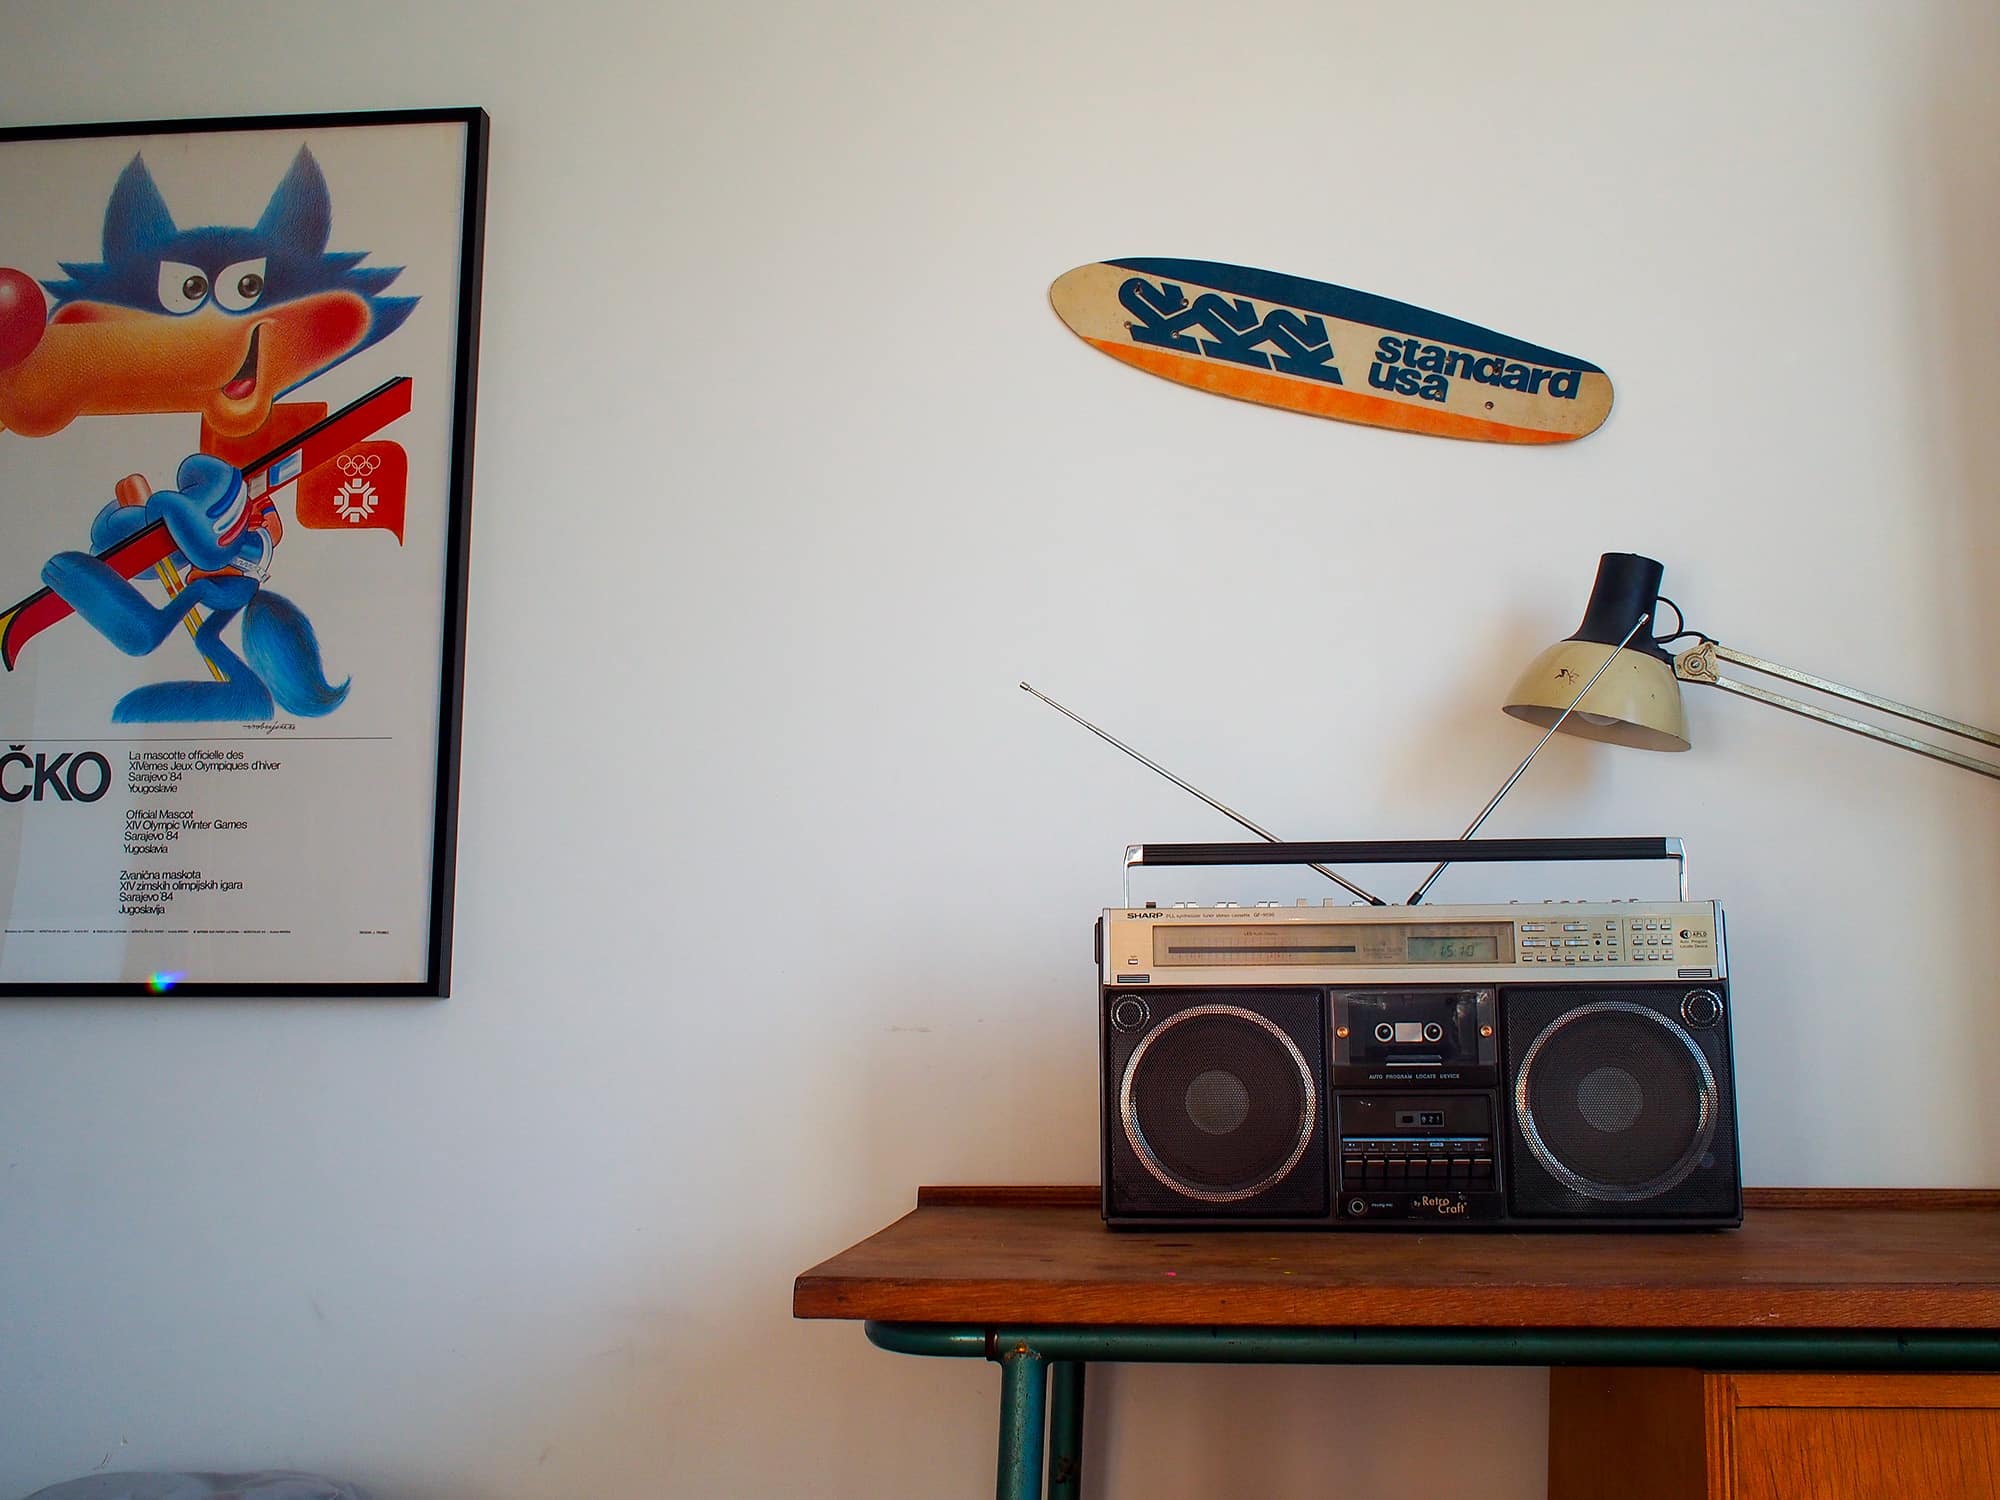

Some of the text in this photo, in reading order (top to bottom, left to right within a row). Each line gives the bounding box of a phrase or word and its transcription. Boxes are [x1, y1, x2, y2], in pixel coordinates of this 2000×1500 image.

[1375, 335, 1582, 400] standard
[1368, 362, 1448, 402] usa
[129, 750, 244, 760] La mascotte officielle des
[170, 761, 193, 771] Jeux
[195, 760, 249, 773] Olympiques
[251, 760, 281, 770] d'hiver
[0, 745, 112, 802] ČKO
[128, 772, 168, 783] Sarajevo
[128, 784, 177, 795] Yougoslavie
[126, 810, 194, 819] Official Mascot
[126, 819, 248, 832] XIV Olympic Winter Games
[124, 831, 164, 842] Sarajevo
[123, 844, 168, 855] Yugoslavia
[162, 869, 201, 879] maskota
[119, 880, 243, 892] XIV zimskih olimpijskih igara
[119, 892, 159, 903] Sarajevo
[118, 904, 165, 915] Jugoslavija
[1438, 1202, 1464, 1214] Craft
